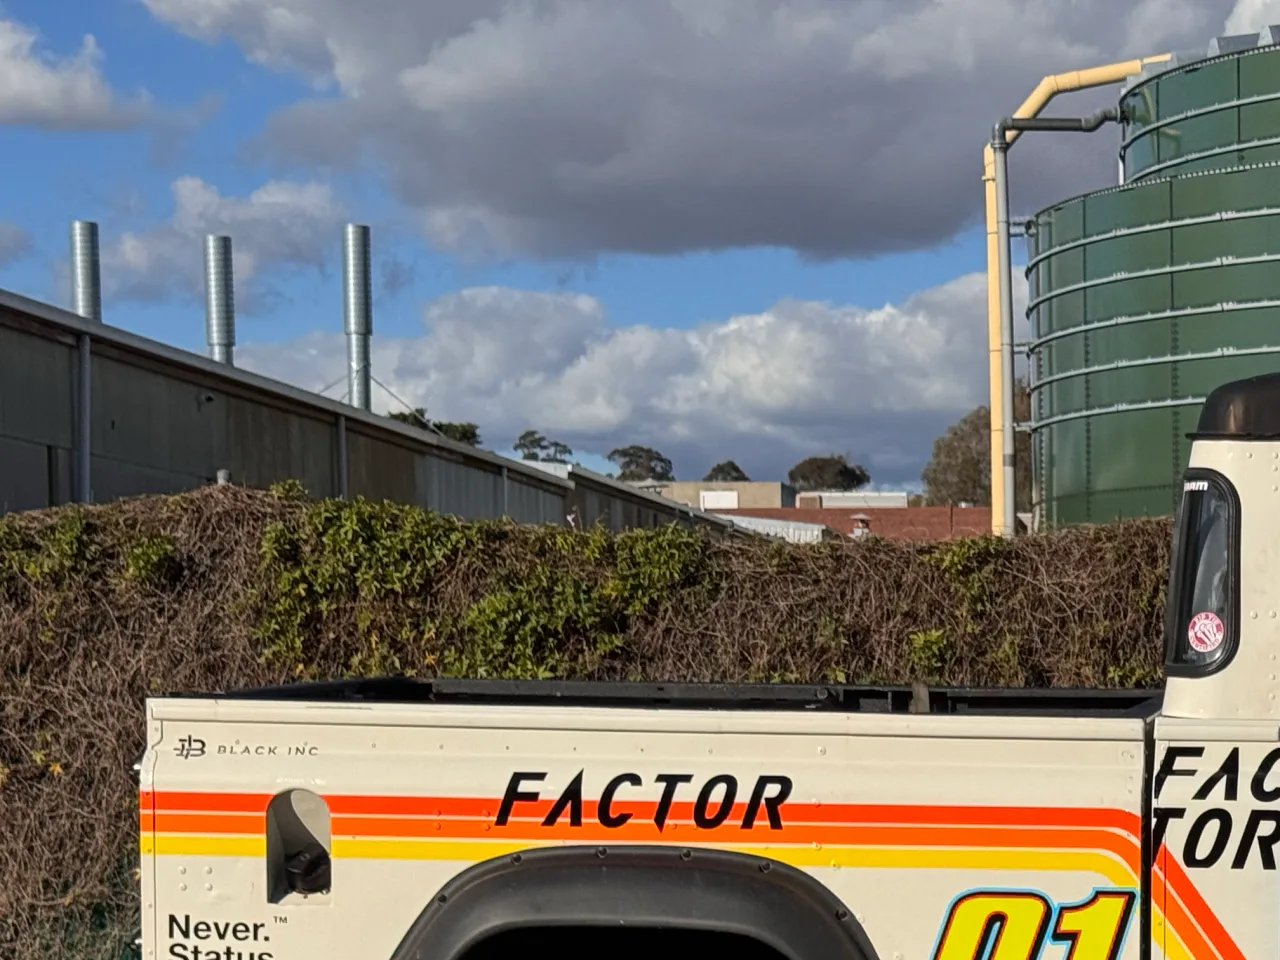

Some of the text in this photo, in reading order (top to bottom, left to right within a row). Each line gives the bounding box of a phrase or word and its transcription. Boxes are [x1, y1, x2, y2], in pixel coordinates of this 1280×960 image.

[216, 745, 319, 757] BLACK INC
[493, 769, 793, 832] FACTOR
[168, 913, 271, 941] Never.
